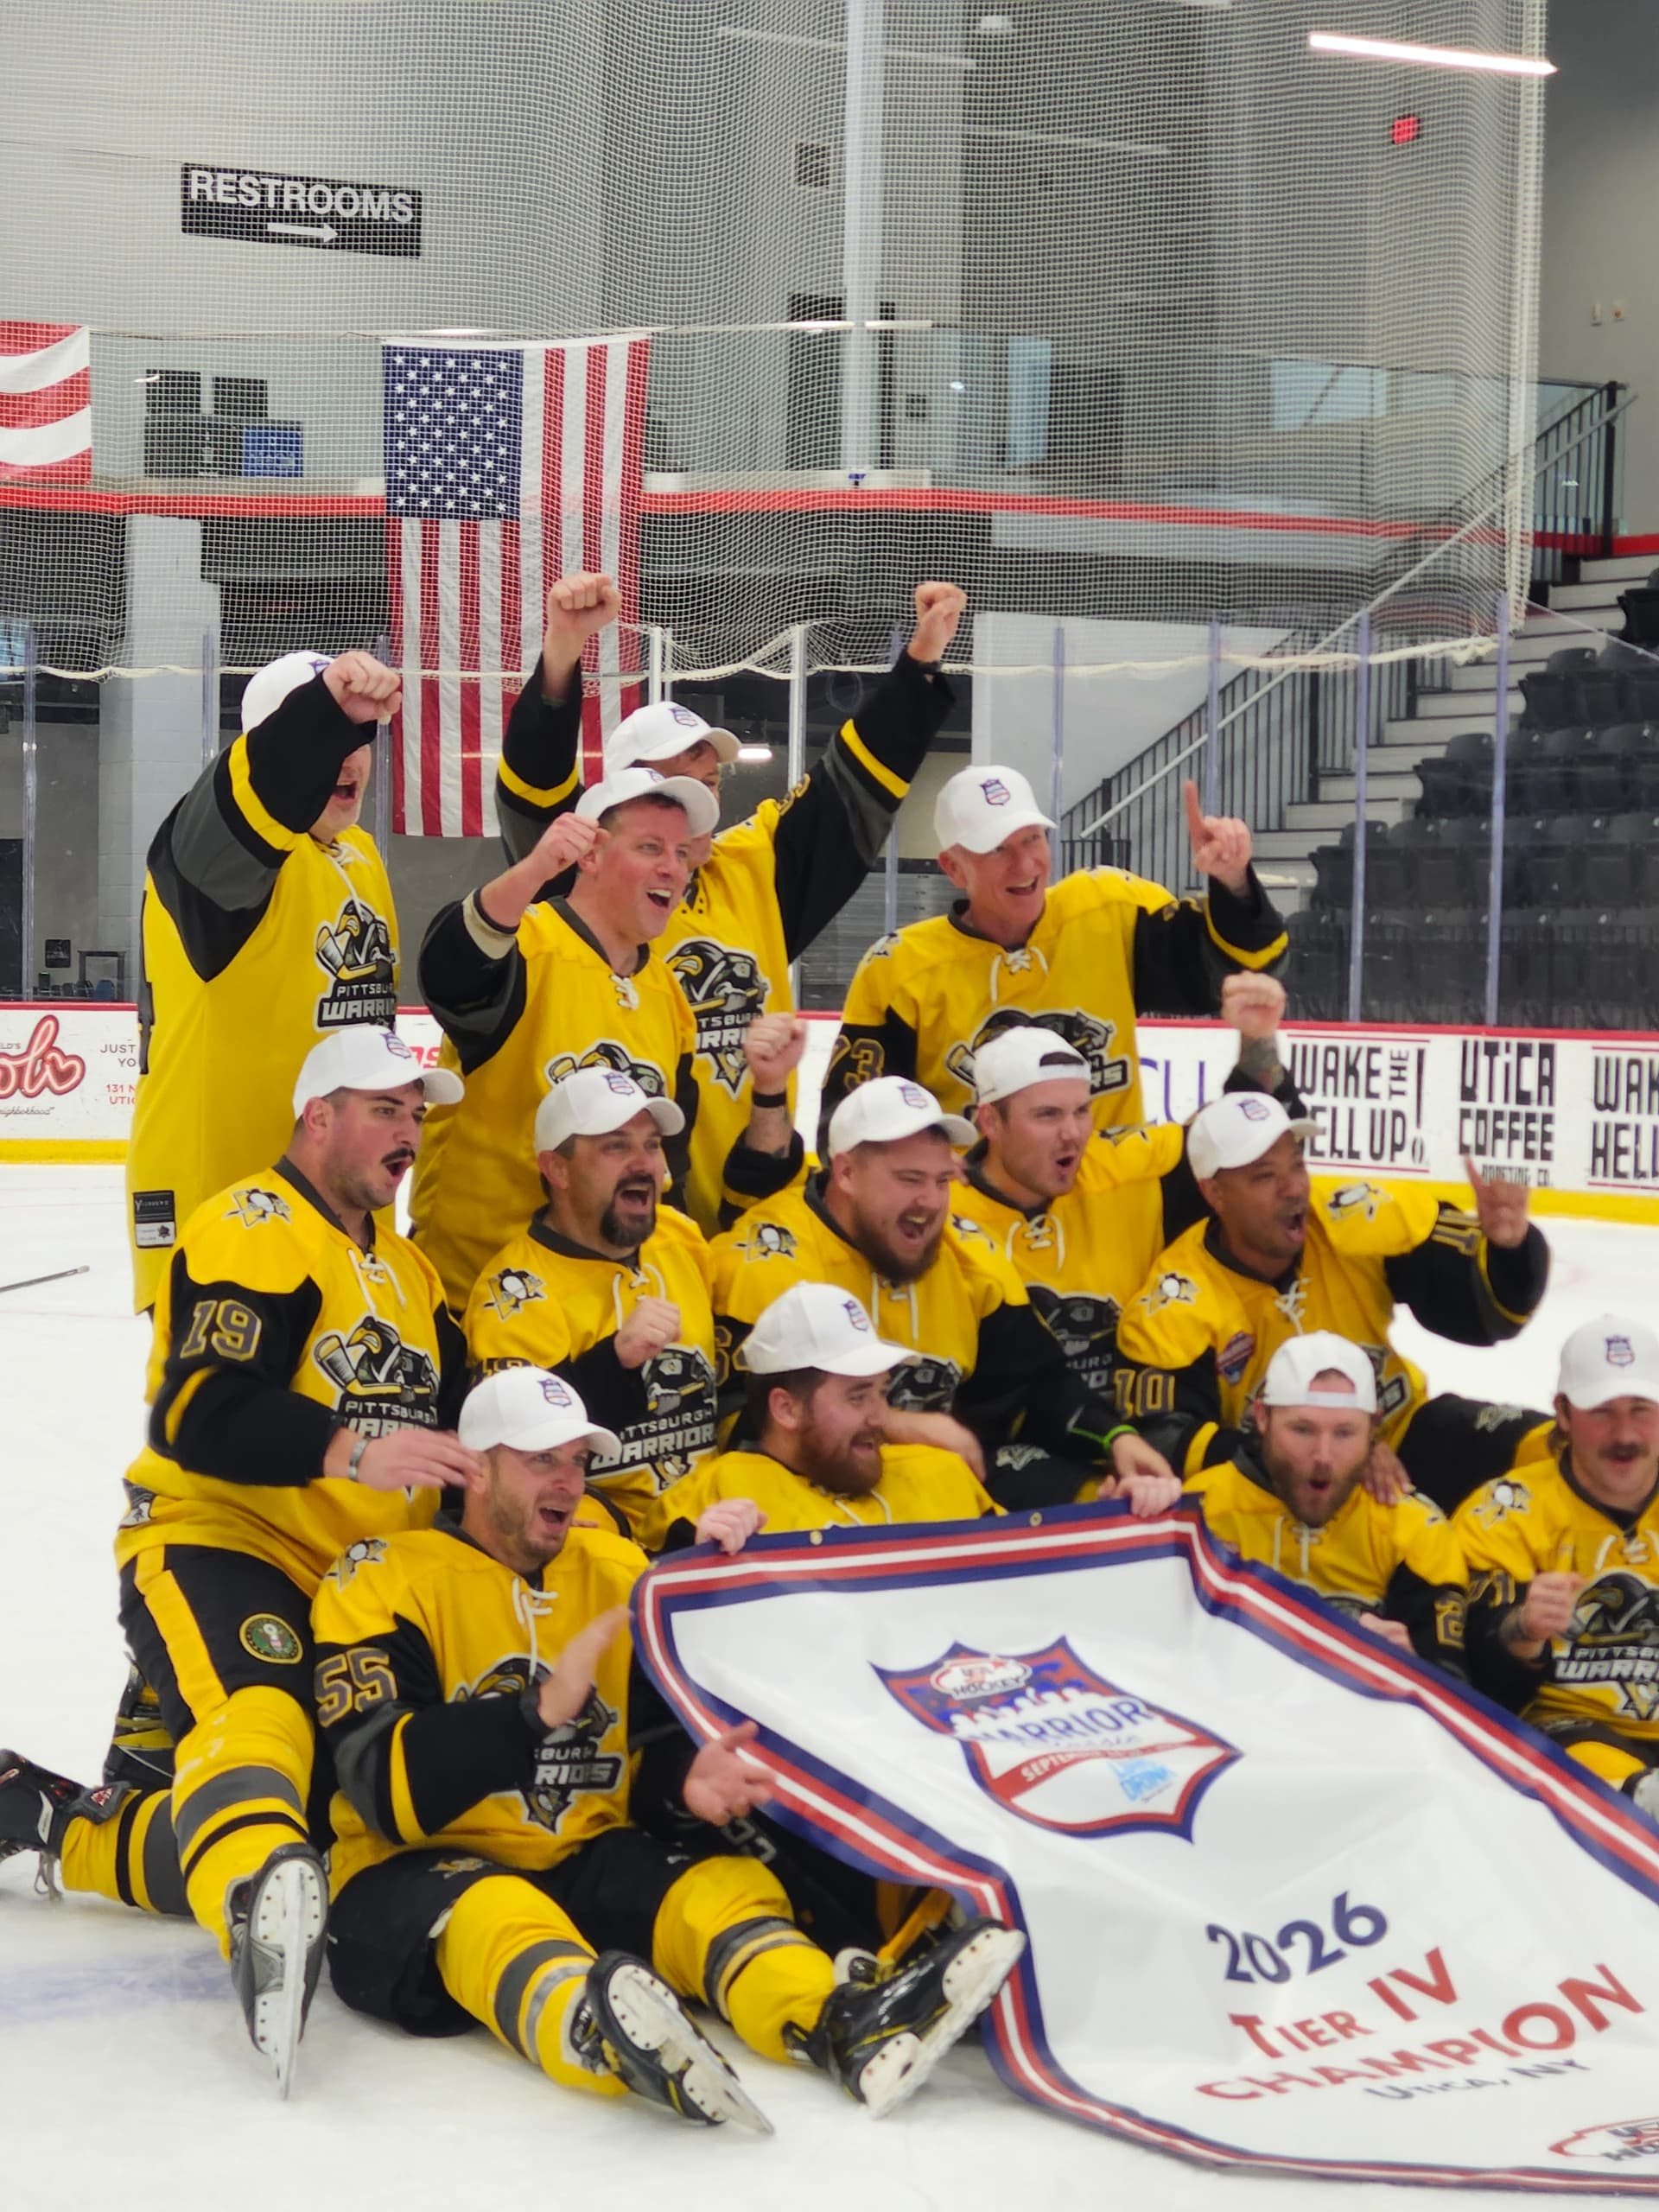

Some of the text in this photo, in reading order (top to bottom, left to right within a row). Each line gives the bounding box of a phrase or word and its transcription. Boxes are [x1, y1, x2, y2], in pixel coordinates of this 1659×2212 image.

[189, 169, 414, 223] RESTROOMS
[105, 1084, 124, 1093] 131
[1290, 1043, 1382, 1099] WAKE
[1389, 1048, 1409, 1101] THE
[1593, 1055, 1659, 1115] WAK
[1309, 1106, 1362, 1160] ELL
[1459, 1107, 1554, 1161] COFFEE
[180, 1299, 262, 1362] 19
[620, 1409, 712, 1440] ITTSBURGH
[314, 1647, 398, 1727] 55
[1205, 1891, 1389, 1985] 2026
[1365, 1946, 1459, 2024] IV
[1194, 1963, 1646, 2100] CHAMPION
[1507, 2057, 1592, 2081] NY
